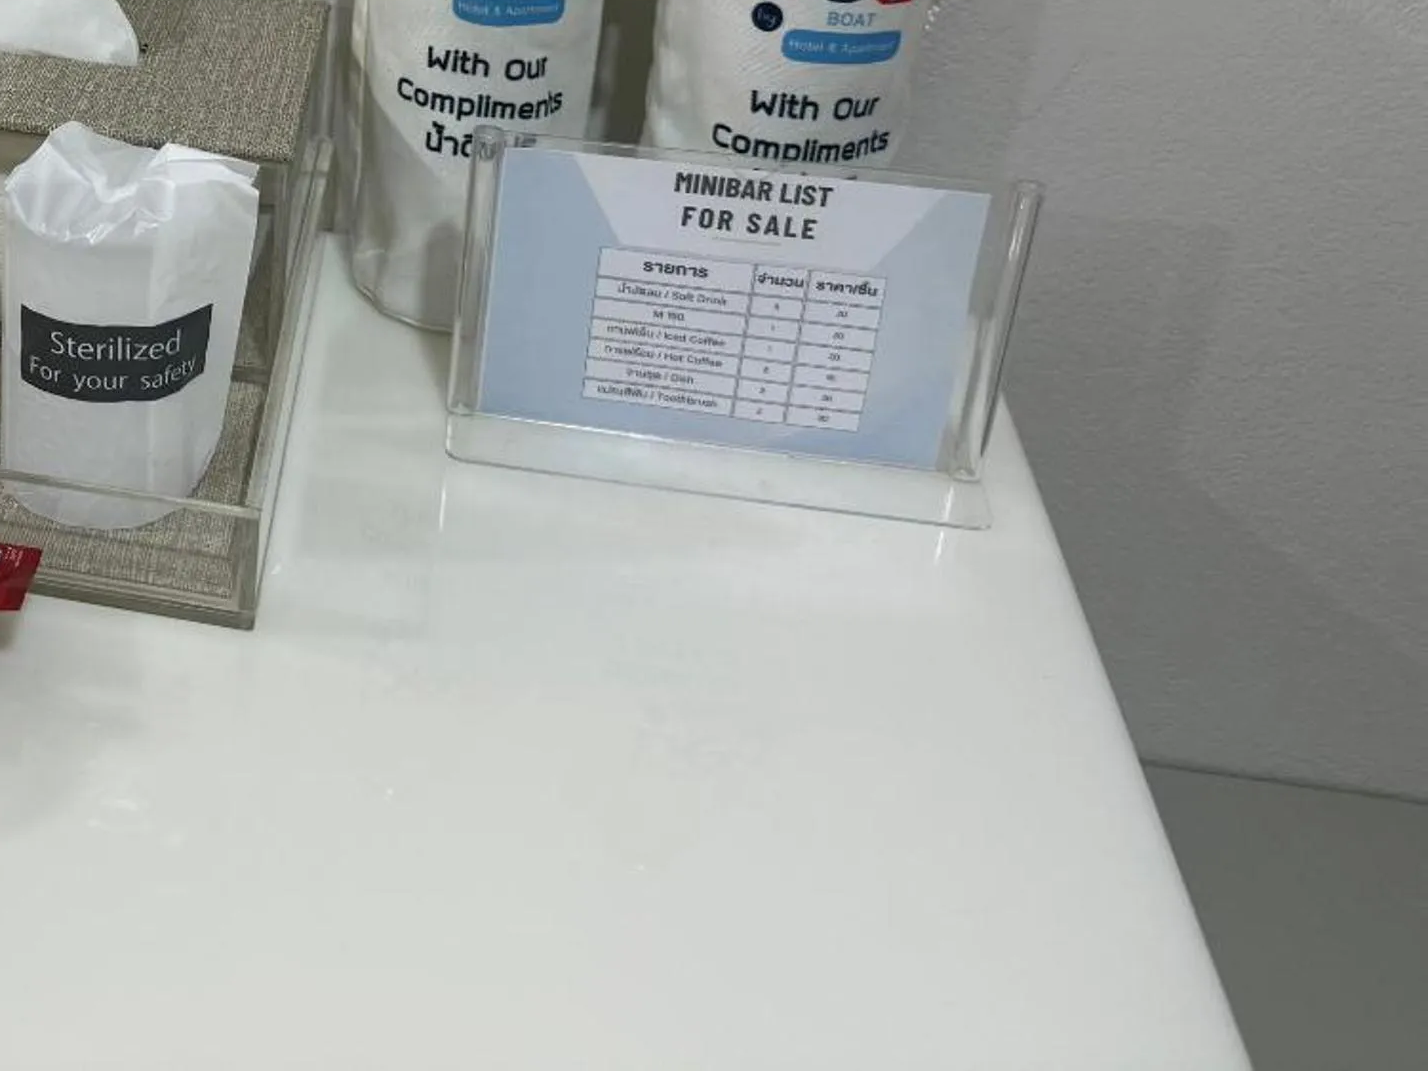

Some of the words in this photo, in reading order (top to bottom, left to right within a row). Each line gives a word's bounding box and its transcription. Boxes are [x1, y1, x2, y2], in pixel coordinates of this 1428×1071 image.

[826, 11, 876, 27] BOAT
[427, 45, 490, 77] With
[504, 56, 548, 81] Our
[397, 77, 563, 121] Compliments
[750, 90, 819, 121] With
[833, 96, 880, 121] Our
[712, 123, 891, 165] Compliments
[674, 172, 773, 202] MINIBAR
[779, 183, 834, 207] LIST
[681, 206, 733, 231] FOR
[746, 213, 818, 240] SALE
[643, 261, 709, 278] รายการ
[757, 272, 804, 288] จำนวน
[50, 329, 182, 362] Sterilized
[29, 355, 62, 382] For
[73, 373, 127, 392] your
[140, 356, 196, 390] safety
